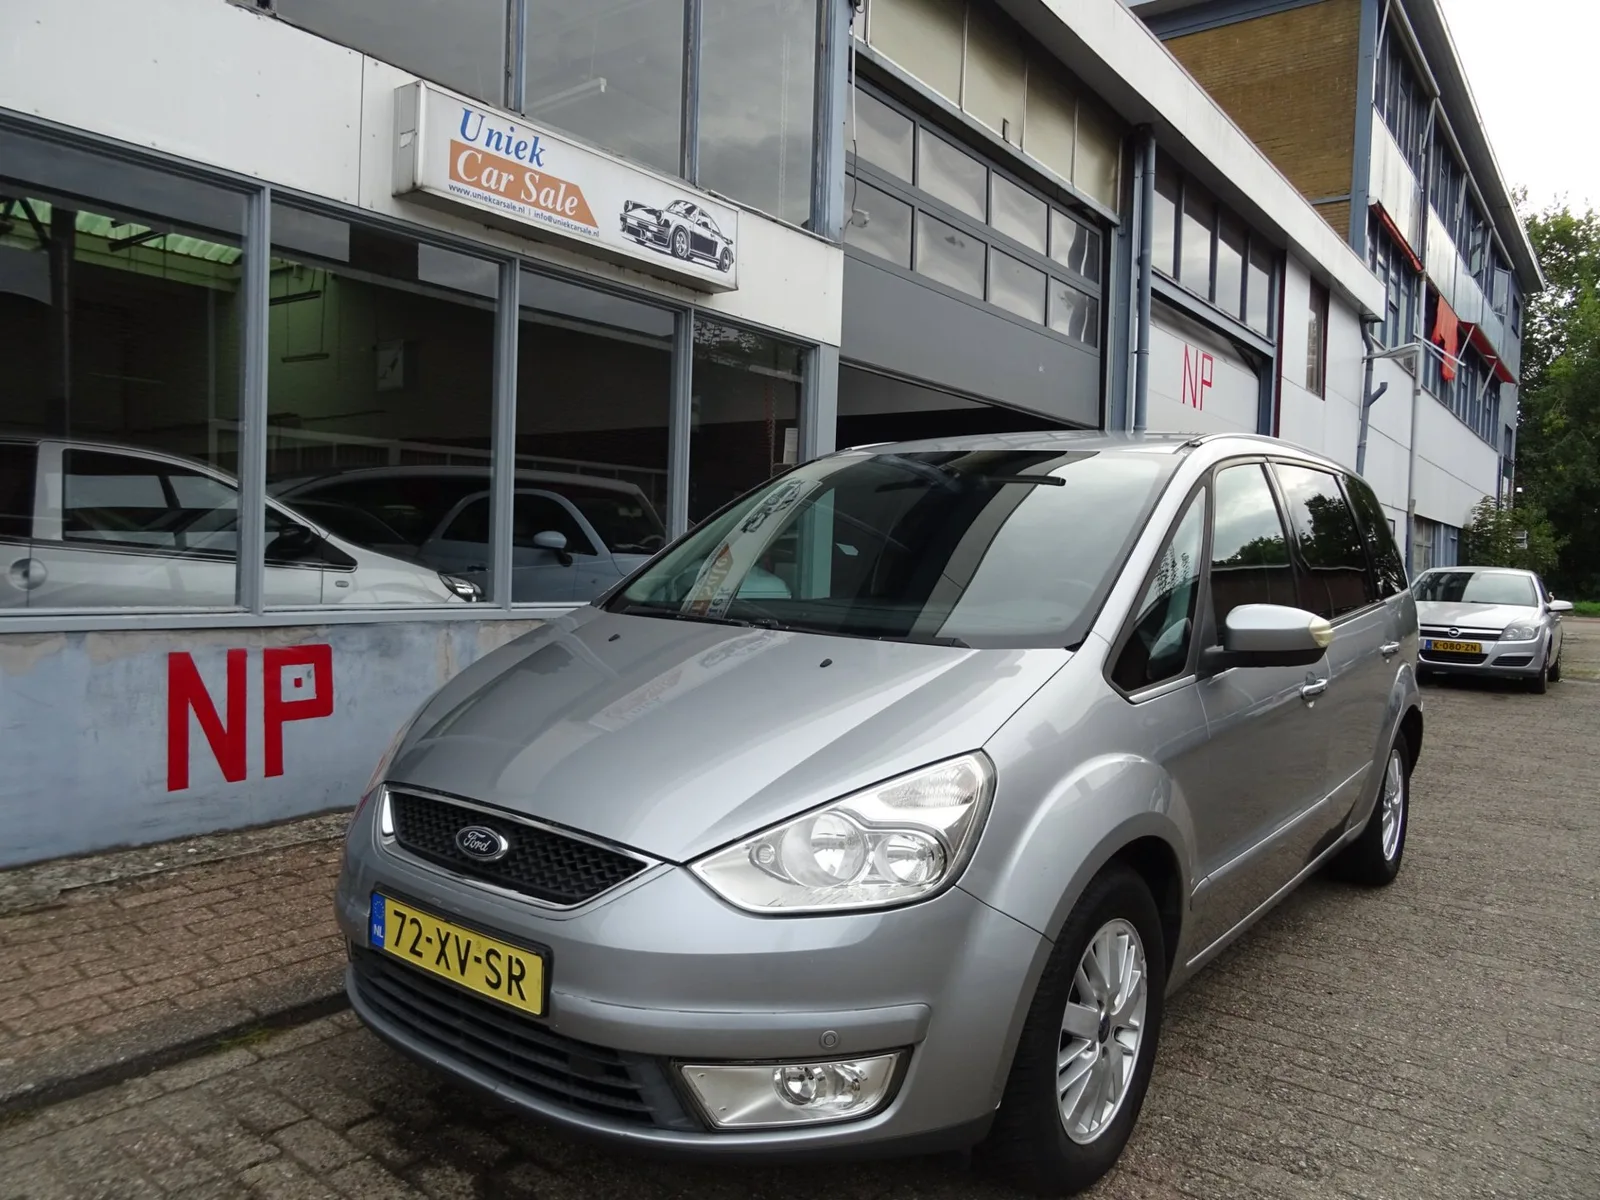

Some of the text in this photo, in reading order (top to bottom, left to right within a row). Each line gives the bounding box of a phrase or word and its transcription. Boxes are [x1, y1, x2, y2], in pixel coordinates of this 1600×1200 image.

[460, 107, 545, 167] Uniek
[448, 184, 600, 238] www.uniekcarsale.nl info@uniekcarsale.nl
[457, 150, 578, 215] Car Sale
[1182, 344, 1213, 411] NP
[168, 644, 334, 792] NP
[463, 831, 491, 852] Ford
[373, 923, 384, 938] NL
[393, 910, 527, 1001] 72-XV-SR
